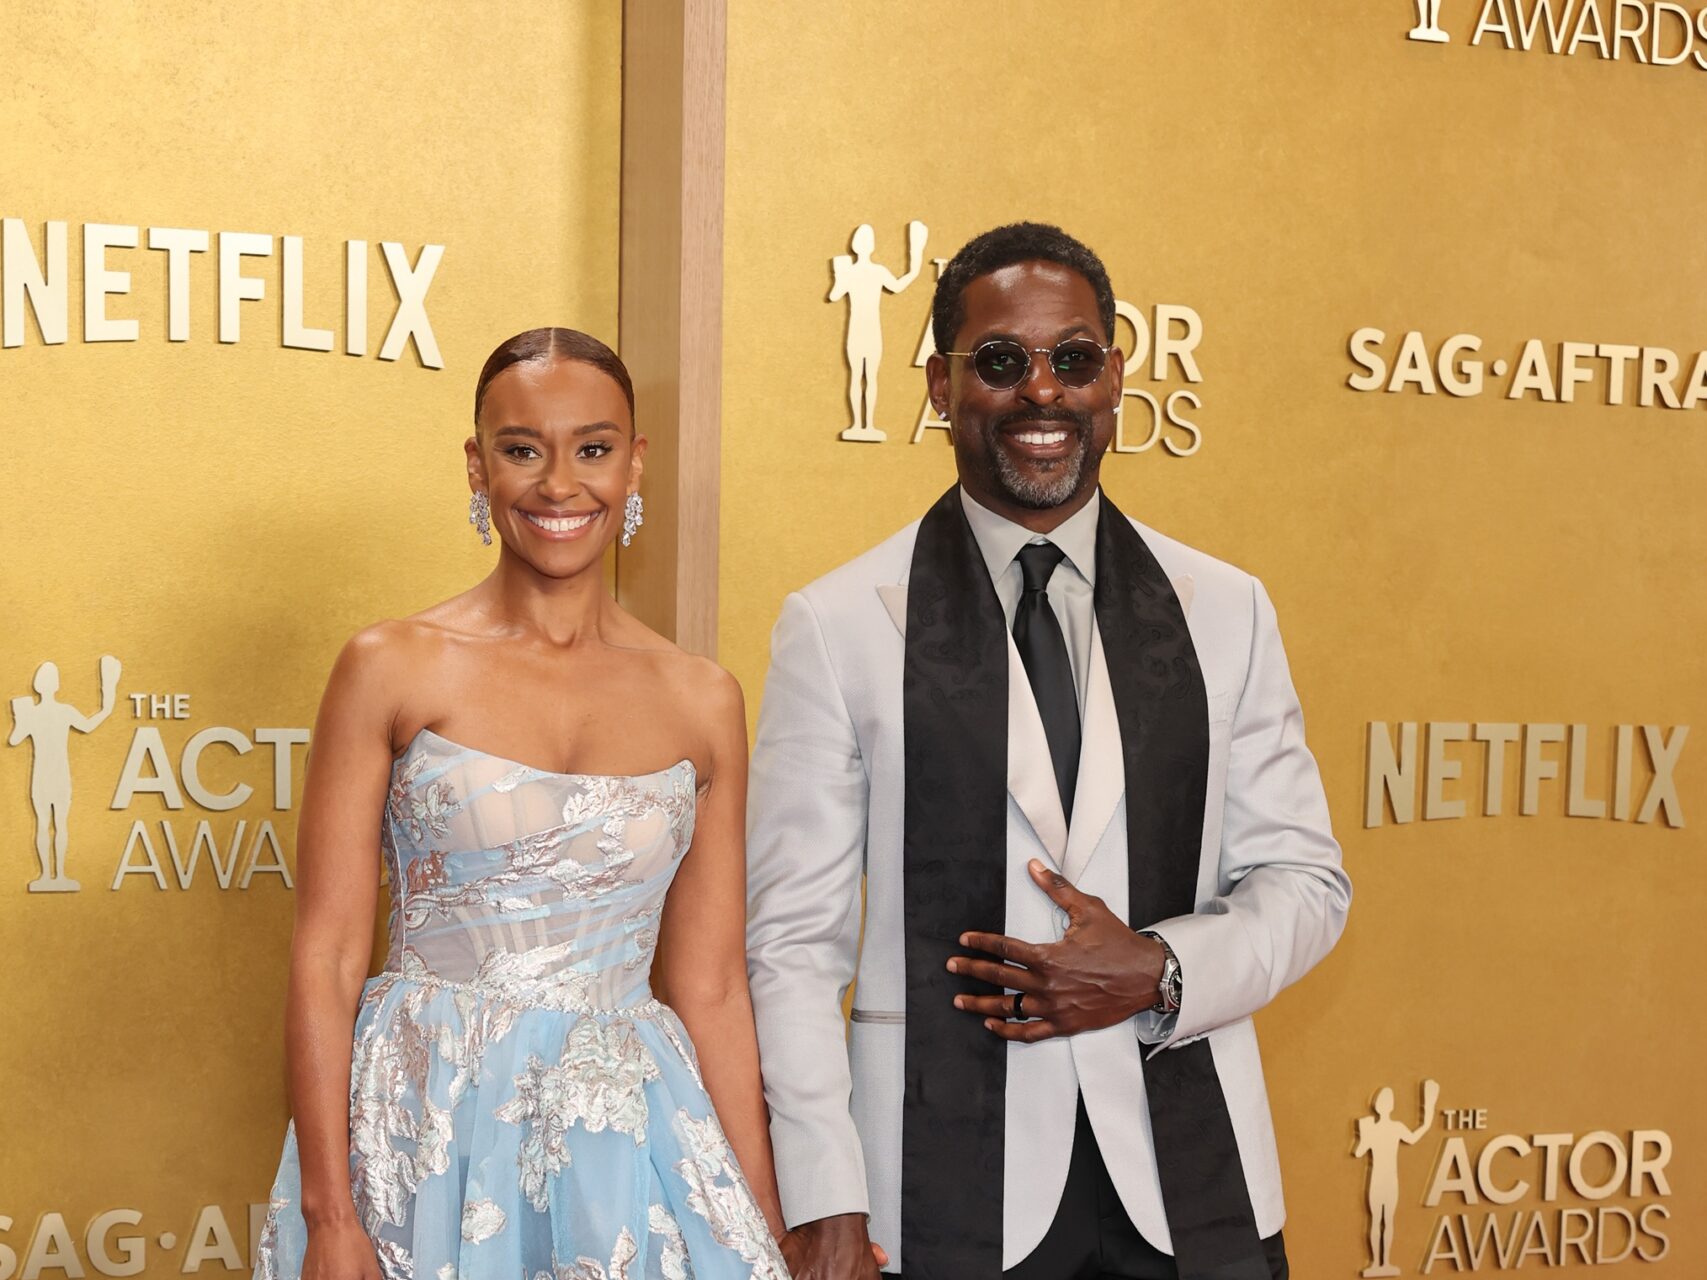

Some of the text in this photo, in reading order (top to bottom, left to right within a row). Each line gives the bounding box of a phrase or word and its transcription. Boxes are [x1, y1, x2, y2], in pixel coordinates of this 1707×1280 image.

[2, 217, 446, 370] NETFLIX
[129, 693, 191, 719] THE
[110, 727, 311, 811] ACT
[1364, 721, 1690, 829] NETFLIX
[111, 820, 295, 890] AWA
[1442, 1108, 1488, 1130] THE
[1424, 1129, 1673, 1207] ACTOR
[1422, 1204, 1672, 1275] AWARDS
